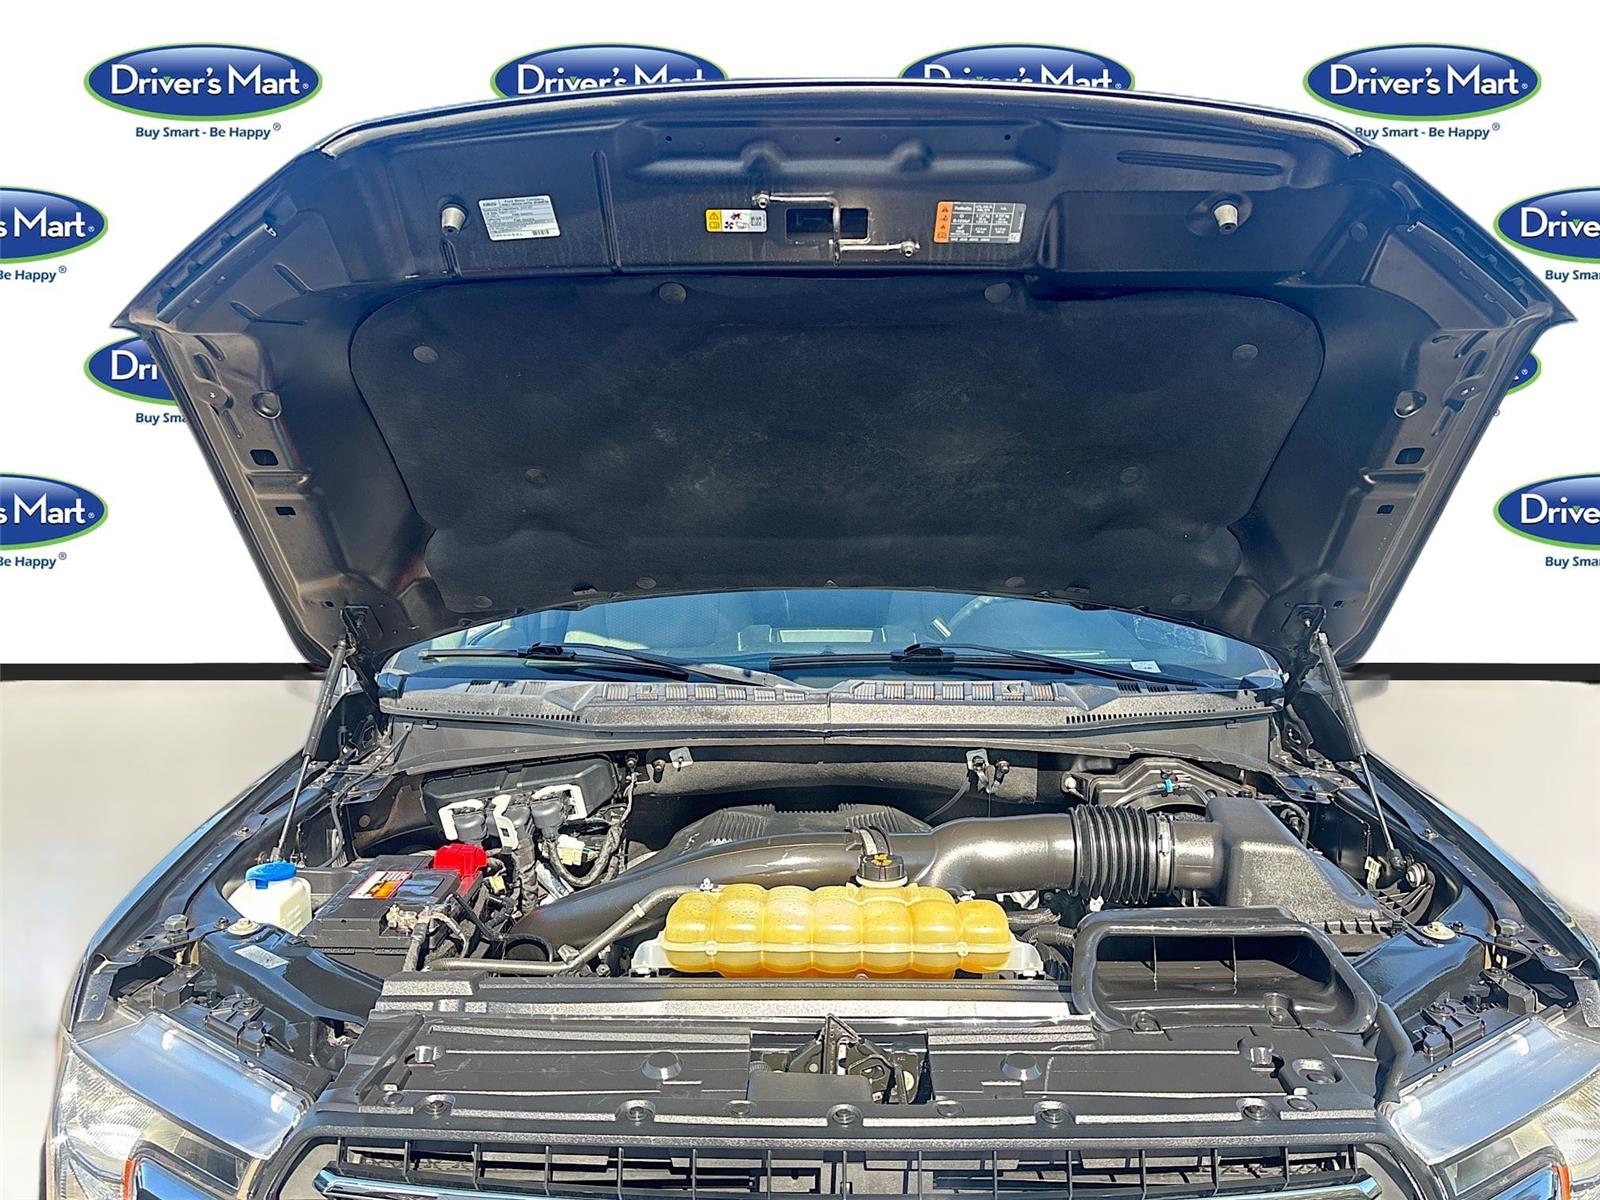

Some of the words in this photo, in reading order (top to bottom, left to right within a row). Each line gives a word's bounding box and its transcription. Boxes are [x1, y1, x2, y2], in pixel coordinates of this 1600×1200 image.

[111, 63, 222, 95] Driver's
[228, 63, 300, 95] Mart
[1330, 63, 1441, 95] Driver's
[1447, 63, 1519, 95] Mart
[135, 126, 160, 140] Buy
[162, 126, 200, 138] Smart
[209, 126, 226, 138] Be
[229, 126, 272, 140] Happy
[1355, 126, 1380, 140] Buy
[1381, 126, 1419, 138] Smart
[1428, 126, 1446, 138] Be
[1448, 126, 1491, 140] Happy
[14, 206, 86, 238] Mart
[15, 269, 57, 283] Happy
[1545, 269, 1570, 283] Buy
[1572, 269, 1600, 280] Sma
[135, 412, 160, 426] Buy
[14, 492, 86, 524] Mart
[15, 556, 57, 570] Happy
[1545, 555, 1570, 570] Buy
[1572, 555, 1600, 567] Sma
